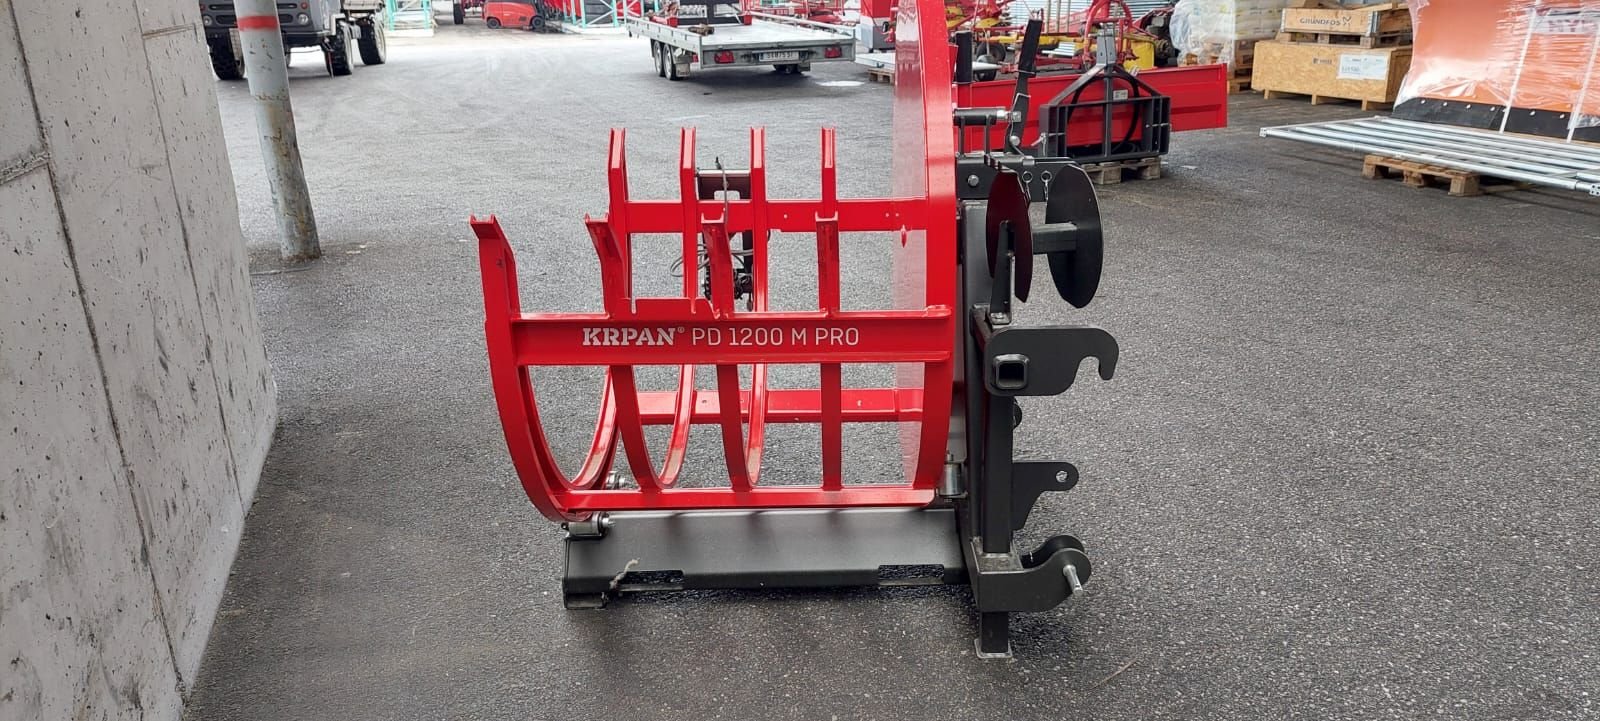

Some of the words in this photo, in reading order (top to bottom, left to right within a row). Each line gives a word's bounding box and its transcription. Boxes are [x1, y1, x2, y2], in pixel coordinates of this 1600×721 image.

[692, 327, 721, 346] PD
[728, 327, 783, 346] 1200
[791, 327, 807, 346] M
[815, 327, 859, 346] PRO
